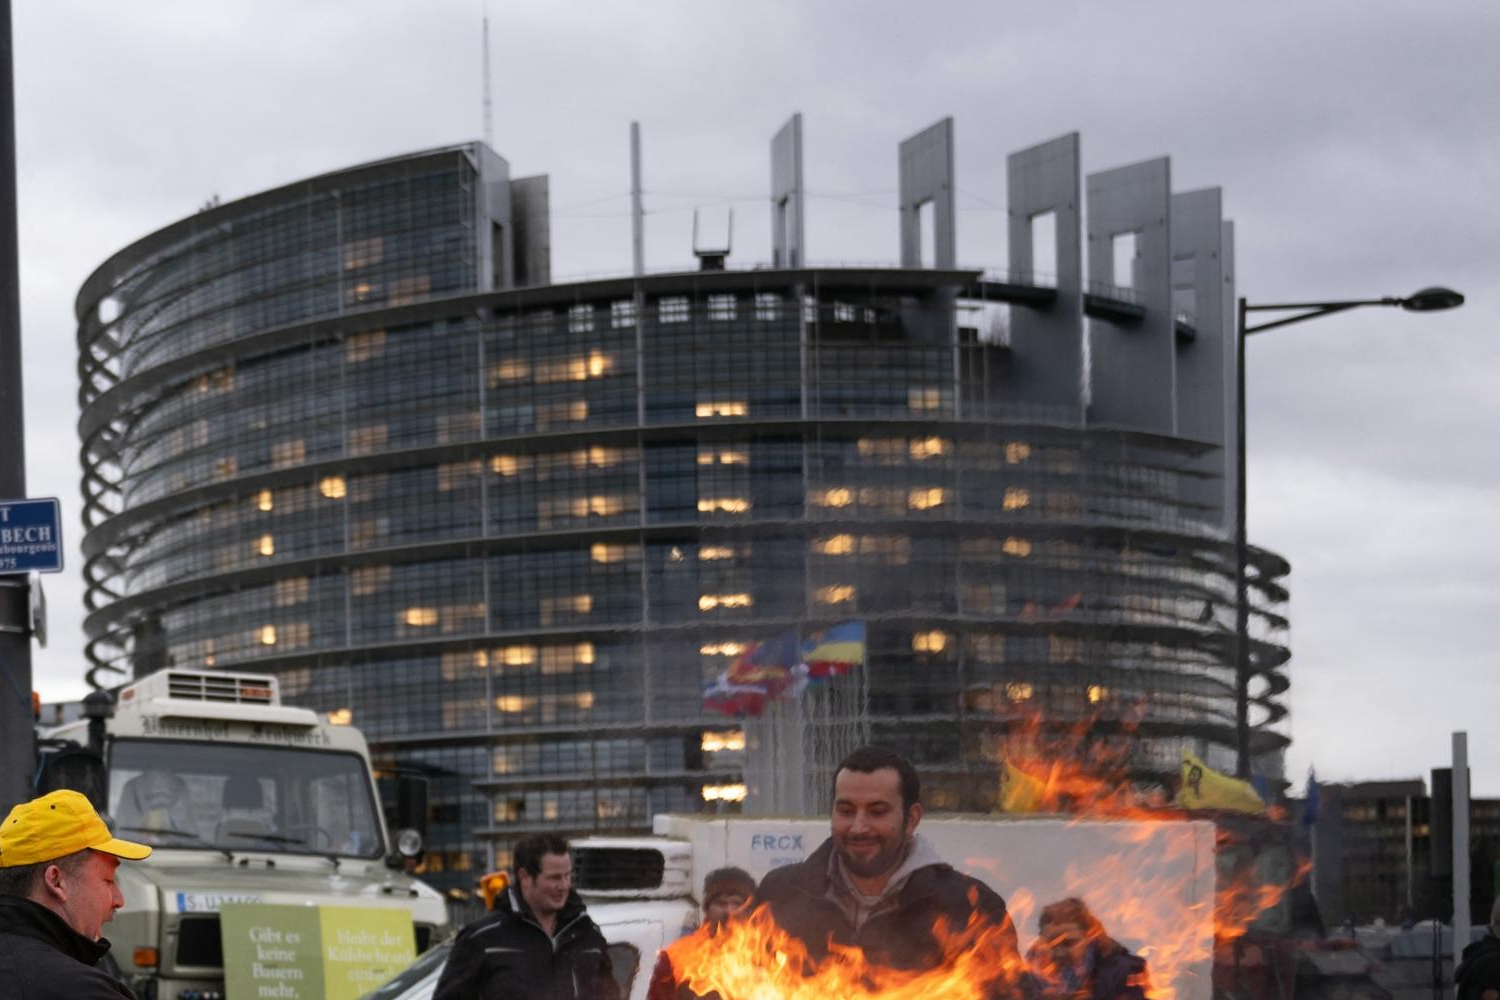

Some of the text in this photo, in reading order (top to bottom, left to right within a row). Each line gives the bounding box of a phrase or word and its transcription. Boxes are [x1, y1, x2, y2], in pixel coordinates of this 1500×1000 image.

[1, 527, 51, 543] BECH
[751, 834, 803, 850] FRCX
[249, 927, 301, 944] Gibt es
[257, 944, 296, 962] keine
[252, 963, 304, 980] Bauern
[258, 980, 299, 999] mehr.
